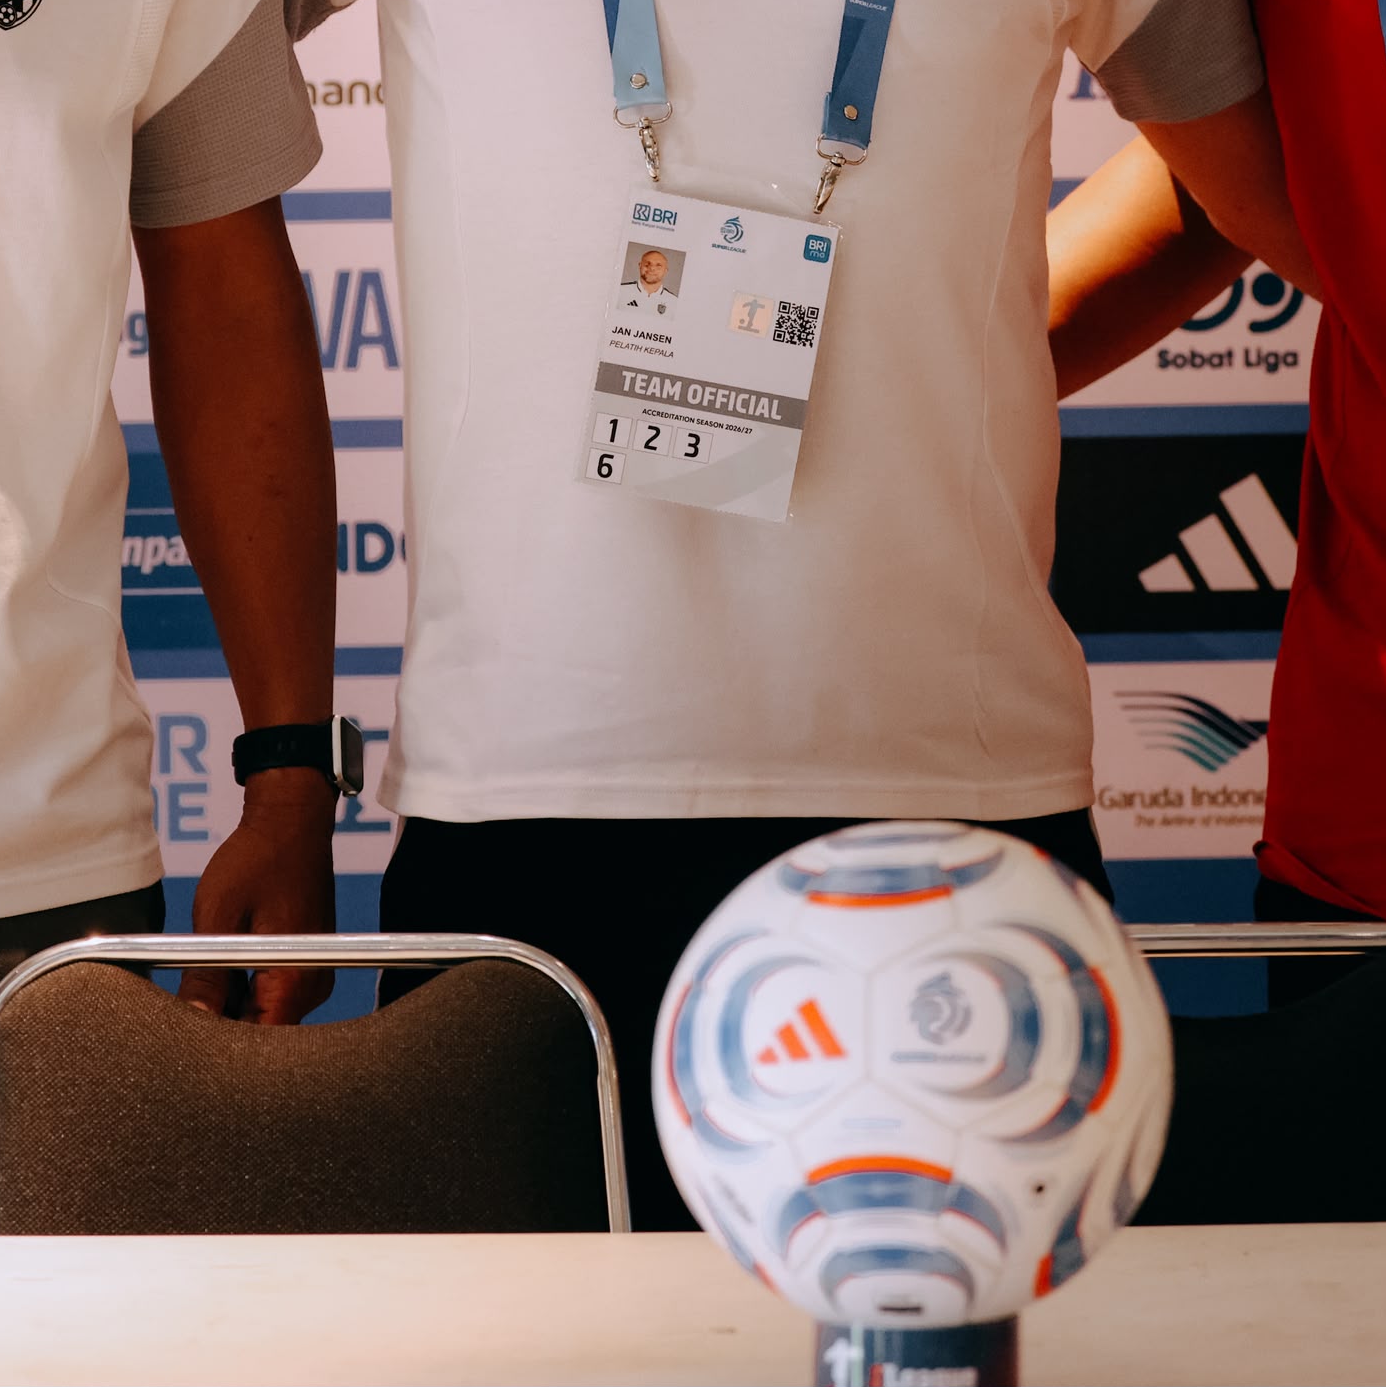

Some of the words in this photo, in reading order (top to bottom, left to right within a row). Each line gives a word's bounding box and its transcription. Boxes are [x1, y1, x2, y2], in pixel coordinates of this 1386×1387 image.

[651, 208, 678, 226] BRI
[809, 239, 827, 252] BRI
[301, 269, 400, 371] VA
[609, 339, 643, 354] PELATIH
[643, 346, 675, 359] KEPALA
[611, 326, 632, 338] JAN
[633, 328, 673, 345] JANSEN
[1156, 347, 1235, 370] Sobat
[1243, 347, 1299, 375] Liga
[620, 370, 683, 401] TEAM
[686, 383, 783, 422] OFFICIAL
[642, 408, 696, 424] ACCREDITATION
[696, 417, 725, 429] SEASON
[725, 422, 753, 436] 2026/27
[608, 418, 619, 443] 1
[643, 425, 662, 451] 2
[684, 432, 702, 459] 3
[596, 453, 615, 479] 6
[1098, 785, 1183, 814] Garuda
